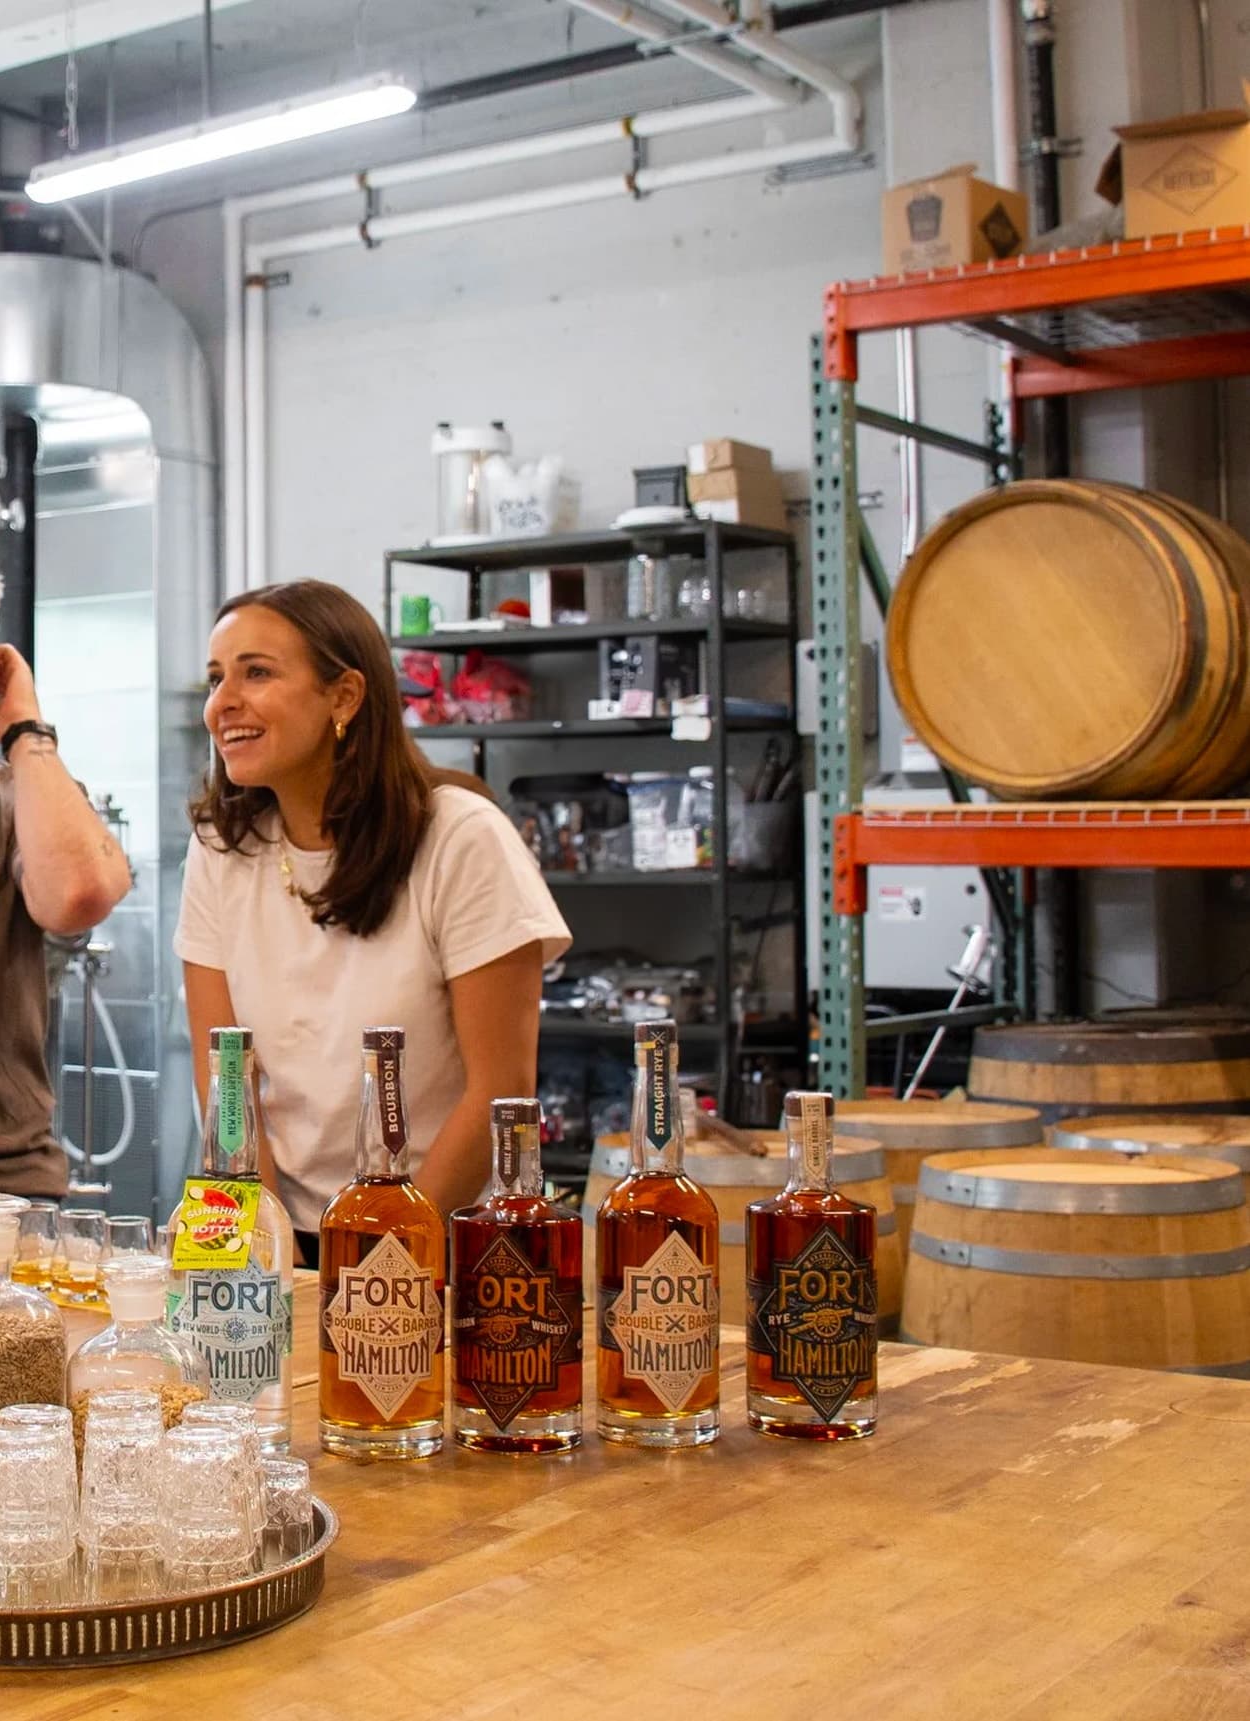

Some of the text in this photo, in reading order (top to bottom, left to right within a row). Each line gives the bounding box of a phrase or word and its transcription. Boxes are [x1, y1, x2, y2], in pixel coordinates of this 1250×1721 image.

[384, 1060, 399, 1133] BOURBON
[654, 1049, 665, 1135] STRAIGHT RYE
[227, 1118, 237, 1136] NEW
[186, 1205, 249, 1220] SUNSHINE
[191, 1225, 240, 1234] BOTTLE
[192, 1280, 277, 1320] FORT
[345, 1275, 431, 1316] FORT
[631, 1275, 712, 1315] FORT
[779, 1270, 864, 1312] FORT
[252, 1322, 284, 1334] DRY GIN
[334, 1317, 376, 1334] DOUBLE
[403, 1318, 438, 1334] BARREL
[531, 1318, 569, 1335] WHISKEY
[618, 1314, 663, 1332] DOUBLE
[768, 1312, 791, 1326] RYE
[196, 1324, 220, 1335] WORLD
[342, 1330, 430, 1375] HAMILTON
[627, 1329, 712, 1372] HAMILTON
[779, 1328, 869, 1376] HAMILTON
